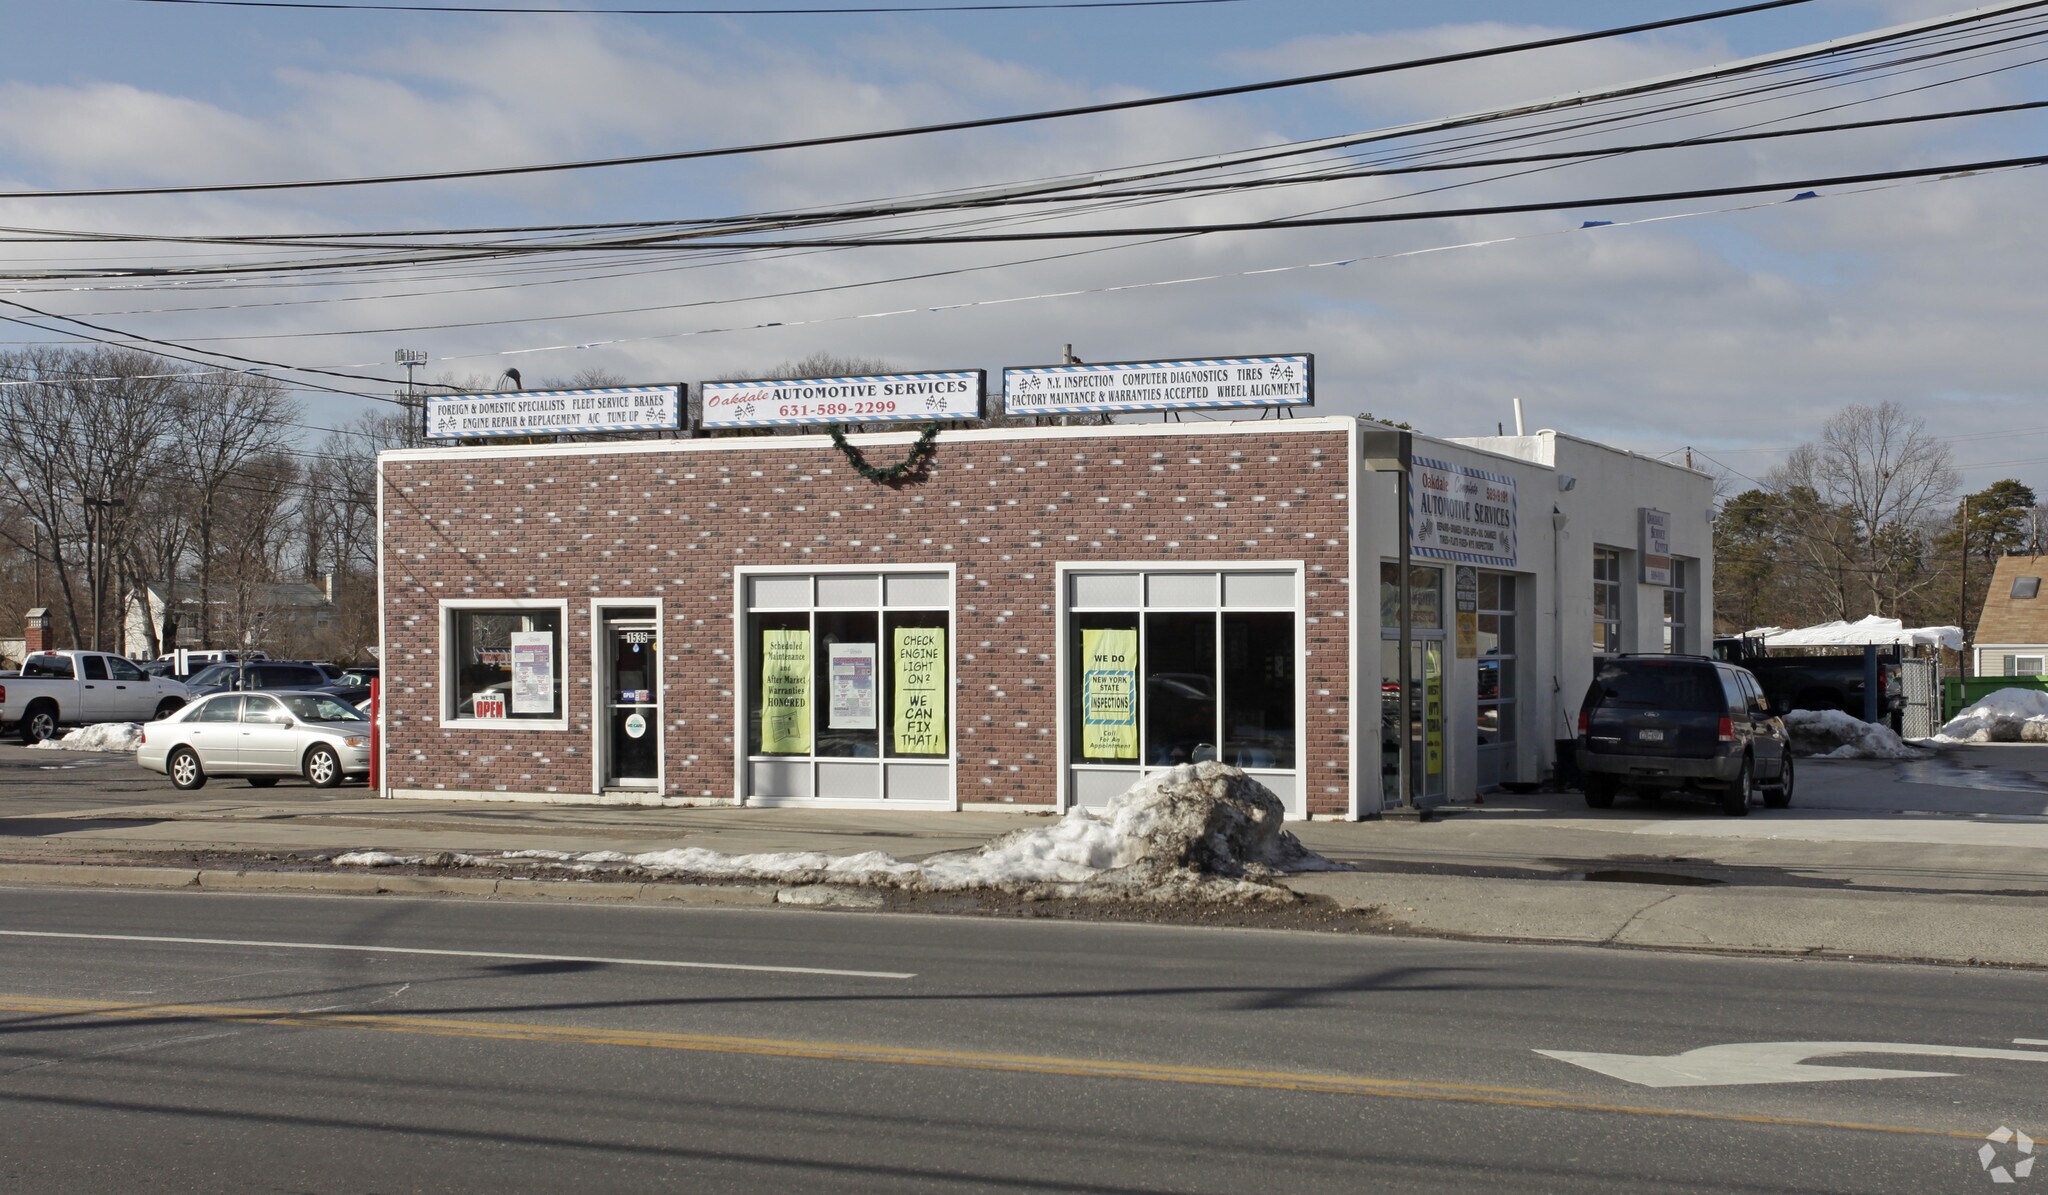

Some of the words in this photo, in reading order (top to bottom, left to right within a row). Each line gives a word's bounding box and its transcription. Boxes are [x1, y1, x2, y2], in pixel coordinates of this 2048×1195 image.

[1047, 376, 1062, 390] N.Y.
[1064, 374, 1115, 389] INSPECTION
[1122, 372, 1168, 387] COMPUTER
[1170, 369, 1229, 385] DIAGNOSTICS
[1237, 368, 1263, 381] TIRES
[708, 389, 769, 408] Oakdale
[771, 384, 878, 401] AUTOMOTIVE
[883, 379, 968, 396] SERVICES
[1011, 393, 1048, 407] FACTORY
[1049, 391, 1096, 405] MAINTANCE
[1099, 390, 1105, 403] &
[1107, 387, 1161, 402] WARRANTIES
[1163, 386, 1208, 400] ACCEPTED
[1217, 384, 1247, 398] WHEEL
[1249, 382, 1301, 397] ALIGNMENT
[437, 403, 469, 415] FOREIGN
[471, 402, 478, 414] &
[479, 400, 516, 414] DOMESTIC
[518, 399, 565, 412] SPECIALISTS
[572, 398, 595, 410] FLEET
[597, 396, 629, 409] SERVICE
[634, 395, 664, 407] BRAKES
[779, 400, 896, 417] 631-589-2299
[462, 417, 490, 429] ENGINE
[491, 415, 518, 428] REPAIR
[519, 415, 526, 427] &
[527, 413, 580, 426] REPLACEMENT
[587, 412, 600, 424] A/C
[607, 411, 627, 423] TUNE
[628, 410, 639, 422] UP
[1421, 493, 1470, 520] AUTOMOTIVE
[1474, 502, 1510, 528] SERVICES
[628, 632, 647, 643] 1535
[903, 635, 935, 646] CHECK
[770, 641, 803, 651] Scheduled
[768, 652, 805, 661] Maintenance
[900, 649, 938, 659] ENGINE
[1094, 655, 1108, 663] WE
[1111, 655, 1125, 663] DO
[780, 664, 791, 672] and
[903, 661, 933, 672] LIGHT
[767, 675, 783, 684] After
[784, 675, 806, 684] Market
[1109, 676, 1127, 684] YORK
[768, 686, 805, 695] Warranties
[1100, 684, 1120, 692] STATE
[768, 697, 805, 707] HONORED
[909, 695, 927, 706] WE
[1091, 696, 1128, 709] INSPECTIONS
[476, 701, 503, 719] OPEN
[905, 708, 932, 719] CAN
[907, 721, 930, 733] FIX
[901, 734, 938, 746] THAT!
[1089, 742, 1131, 750] Appointment
